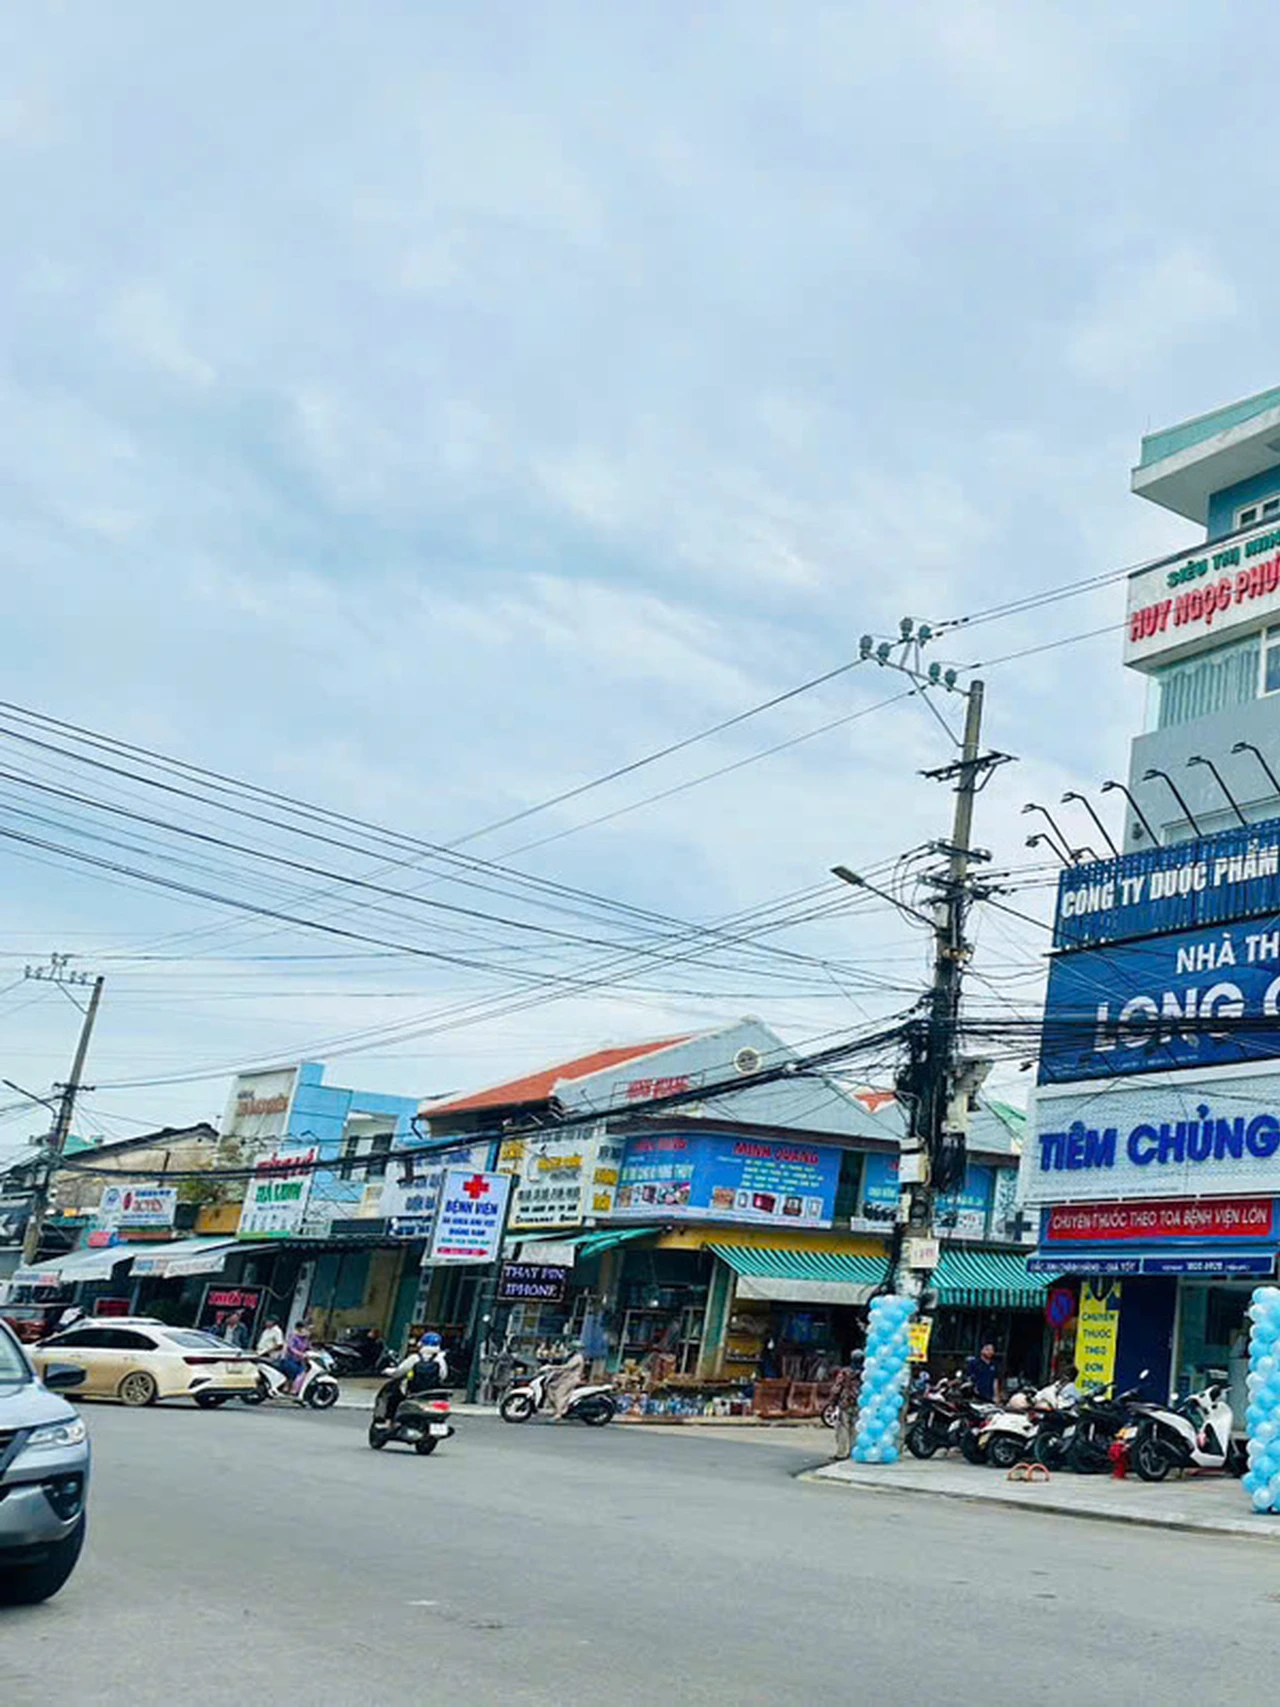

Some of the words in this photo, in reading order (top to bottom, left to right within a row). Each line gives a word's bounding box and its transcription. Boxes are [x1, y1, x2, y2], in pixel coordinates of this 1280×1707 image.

[1167, 559, 1209, 588] SIÊU
[1212, 546, 1241, 571] THỊ
[1129, 598, 1173, 642] HUY
[1173, 576, 1233, 625] NGỌC
[1061, 881, 1115, 919] CÔNG
[1120, 877, 1146, 909] TY
[1149, 863, 1207, 904] DƯỢC
[1213, 838, 1279, 890] PHẨM
[1176, 930, 1237, 975] NHÀ
[1093, 982, 1246, 1053] LONG
[1038, 1120, 1118, 1172] TIÊM
[445, 1198, 474, 1214] BỆNH
[475, 1200, 498, 1216] VIỆN
[1129, 1209, 1158, 1227] THEO
[1159, 1209, 1182, 1227] TOA
[1183, 1203, 1213, 1229] BỆNH
[1214, 1205, 1241, 1228] VIỆN
[504, 1265, 540, 1279] THAY
[541, 1268, 566, 1280] PIN
[504, 1282, 558, 1296] IPHONE
